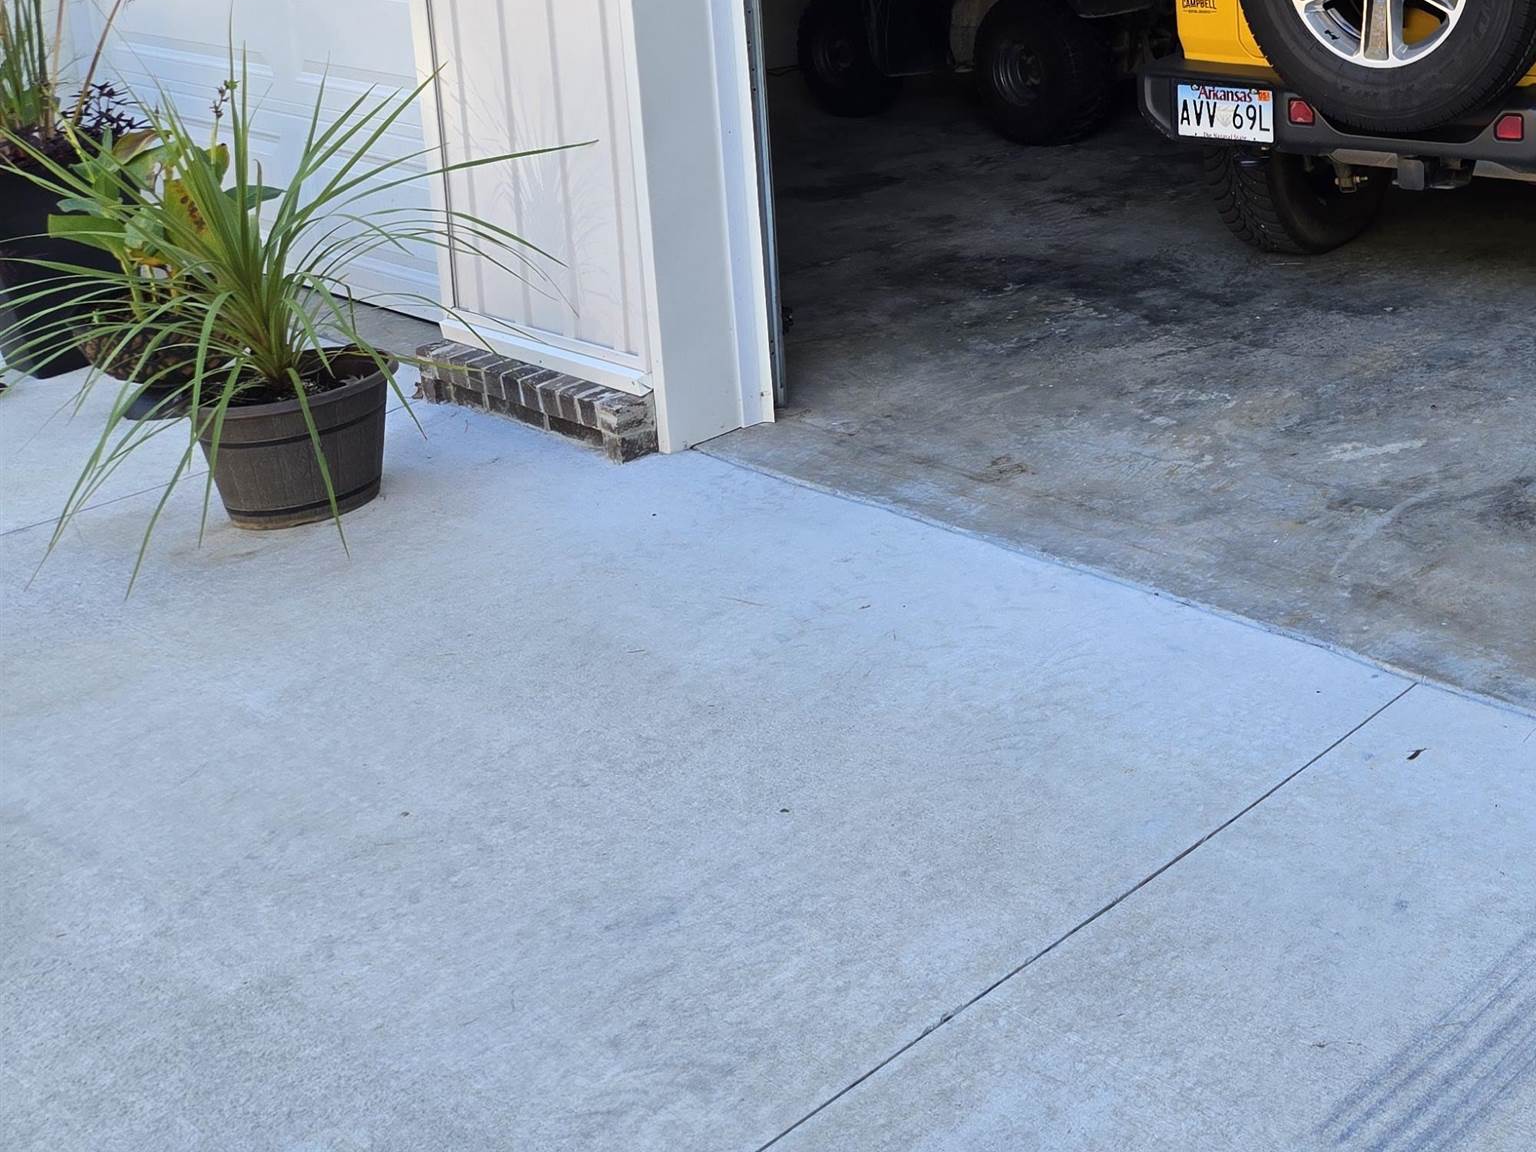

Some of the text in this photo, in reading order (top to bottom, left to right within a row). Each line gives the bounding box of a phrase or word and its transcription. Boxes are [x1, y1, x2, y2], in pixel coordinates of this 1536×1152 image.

[1198, 85, 1253, 103] Arkansas
[1180, 99, 1270, 132] AVV 69L
